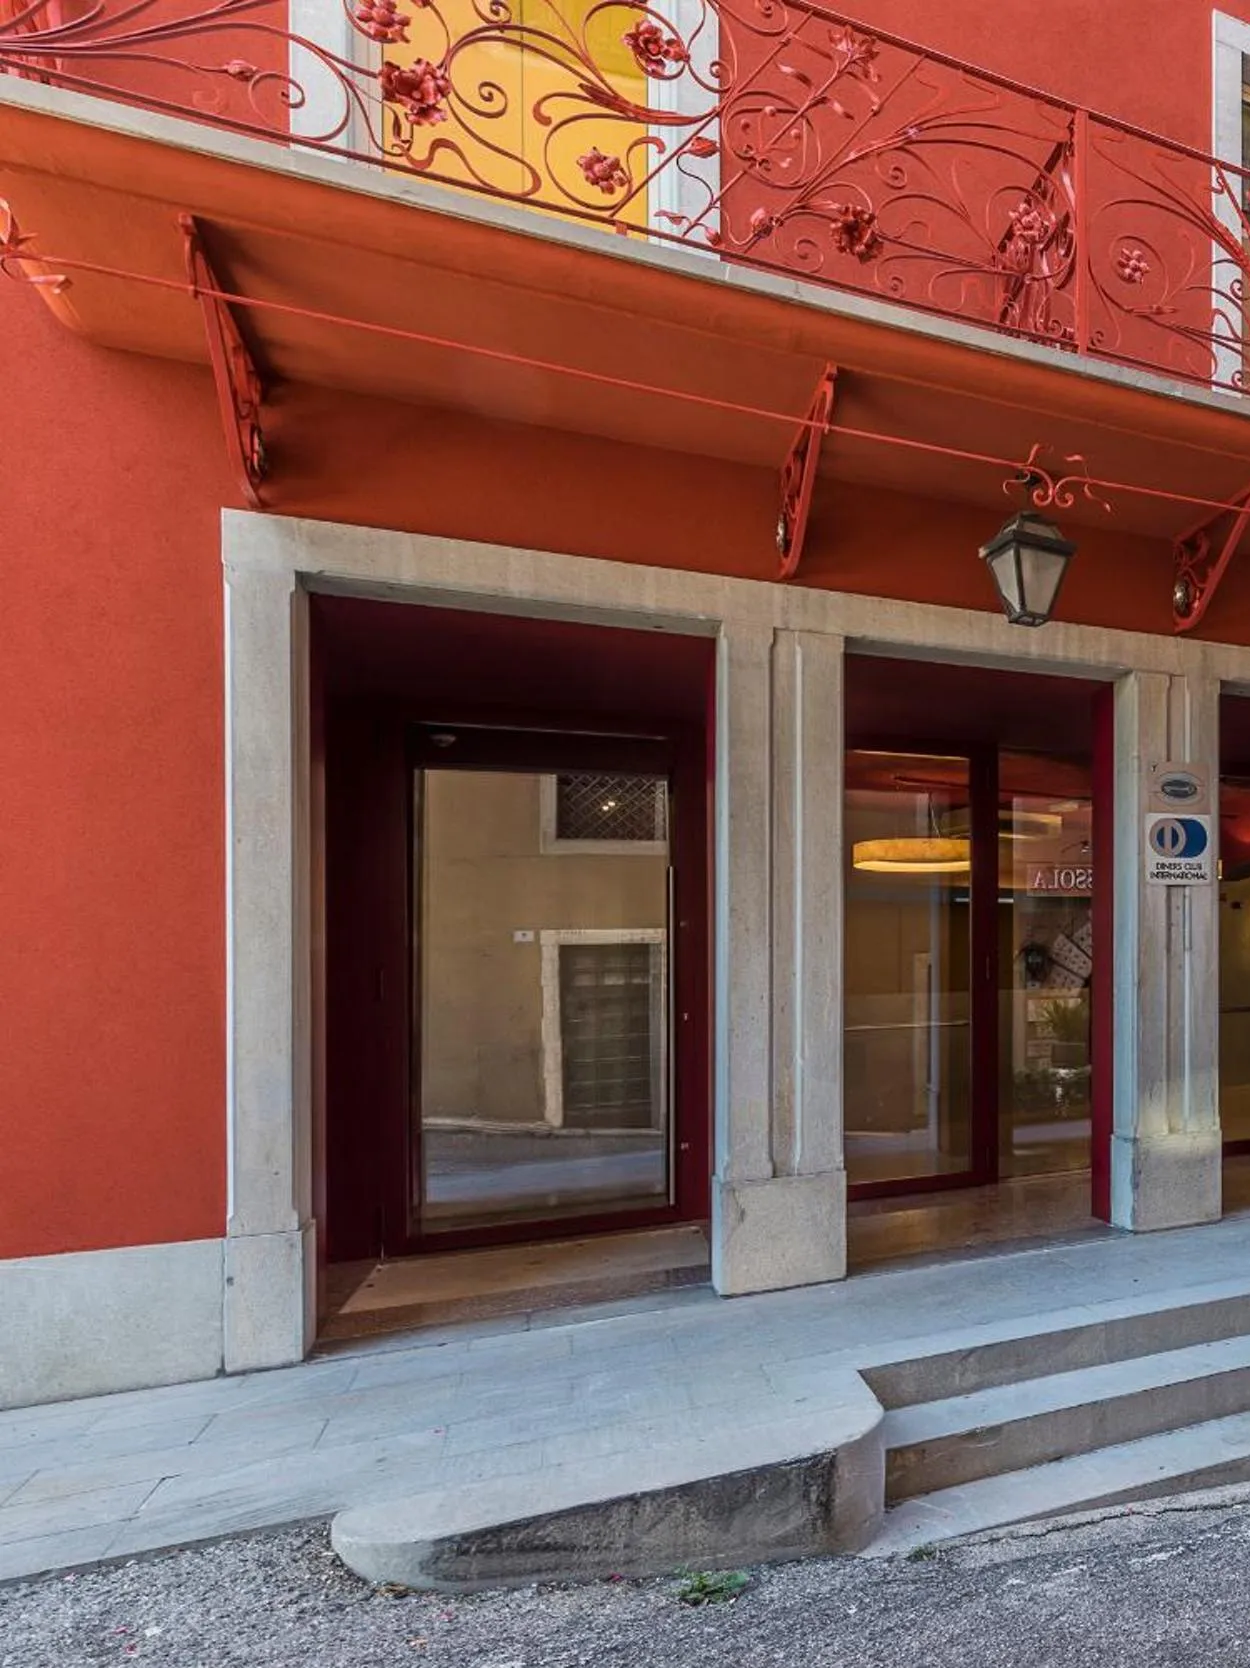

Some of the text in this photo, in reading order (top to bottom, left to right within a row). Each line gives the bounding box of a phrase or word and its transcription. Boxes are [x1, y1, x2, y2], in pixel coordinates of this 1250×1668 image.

[1155, 862, 1202, 871] DINERS CLUB
[1149, 870, 1208, 880] INTERNATIONAL
